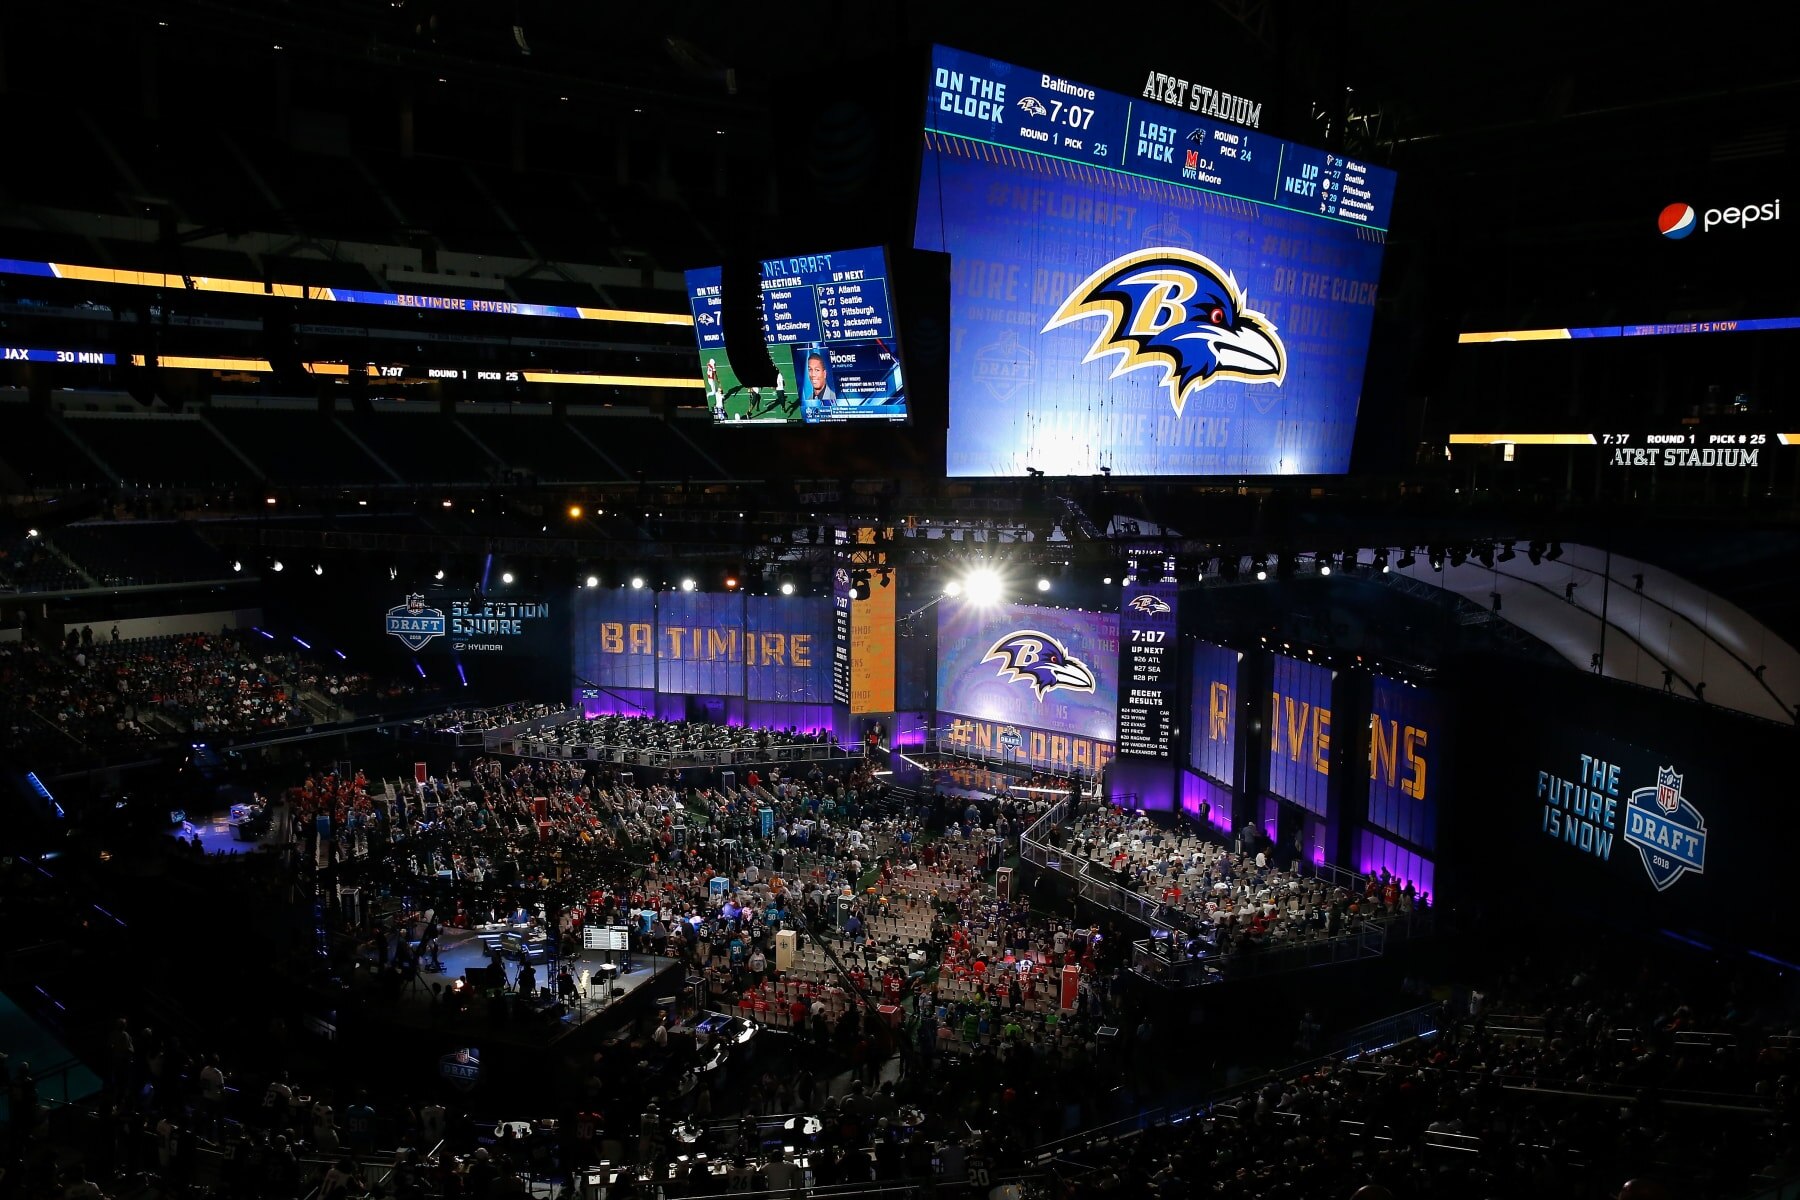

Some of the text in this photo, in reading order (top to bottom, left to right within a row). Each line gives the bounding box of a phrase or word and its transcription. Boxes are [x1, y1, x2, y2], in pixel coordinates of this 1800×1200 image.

[935, 67, 1007, 103] ON THE
[1041, 74, 1096, 101] Baltimore
[940, 91, 1005, 124] CLOCK
[1142, 70, 1262, 129] AT&T STADIUM
[1050, 100, 1095, 130] 7:07
[1139, 120, 1177, 145] LAST
[1214, 130, 1248, 147] ROUND 1
[1020, 127, 1108, 156] ROUND 1 PICK 25
[1137, 139, 1175, 164] PICK
[1220, 146, 1252, 162] PICK 24
[1200, 158, 1215, 172] D.J.
[1301, 163, 1319, 180] UP
[1335, 158, 1367, 174] 26 Atlanta
[1182, 168, 1222, 185] WR Moore
[1333, 170, 1365, 186] 27 Seattle
[1285, 176, 1317, 198] NEXT
[1330, 182, 1371, 199] 28 Pittsburgh
[1329, 193, 1375, 212] 29 Jacksonville
[1327, 205, 1368, 222] 30 Minnesota
[1704, 198, 1781, 233] pepsi
[763, 254, 832, 278] NFL DRAFT
[761, 276, 802, 290] SELECTIONS
[833, 270, 864, 282] UP NEXT
[696, 285, 720, 297] ON THE
[826, 285, 861, 296] 26 Atlanta
[1273, 267, 1379, 307] ON THE CLOCK
[770, 291, 792, 300] Nelson
[827, 296, 863, 306] 27 Seattle
[397, 294, 519, 314] BALTIMORE RAVENS
[829, 306, 875, 317] 28 Pittsburgh
[774, 312, 792, 321] Smith
[831, 316, 883, 327] 29 Jacksonville
[776, 322, 811, 331] McGlinchey
[832, 328, 878, 339] 30 Minnesota
[1636, 321, 1737, 336] THE FUTURE IS NOW
[767, 333, 797, 342] 10 Rosen
[4, 349, 104, 364] JAX 30 MIN
[830, 354, 857, 363] MOORE
[879, 353, 891, 361] WR
[381, 366, 403, 377] 7:07
[428, 368, 458, 379] ROUND
[462, 370, 467, 380] 1
[505, 372, 519, 381] 25
[1156, 416, 1231, 449] RAVENS
[1647, 434, 1685, 444] ROUND
[1688, 434, 1696, 444] 1
[1709, 434, 1736, 444] PICK
[1749, 434, 1766, 445] 25
[1663, 448, 1760, 467] STADIUM
[390, 619, 441, 631] DRAFT
[1131, 629, 1166, 643] 7:07
[467, 643, 503, 651] HYUNDAI
[1143, 646, 1164, 655] NEXT
[1129, 697, 1163, 706] RESULTS
[1131, 689, 1162, 698] RECENT
[1000, 736, 1020, 745] DRAFT
[1580, 753, 1621, 797] THE
[1537, 770, 1618, 830] FUTURE
[1658, 785, 1679, 809] NFL
[1542, 805, 1614, 862] IS NOW
[1631, 812, 1699, 858] DRAFT
[1652, 854, 1670, 870] 2018
